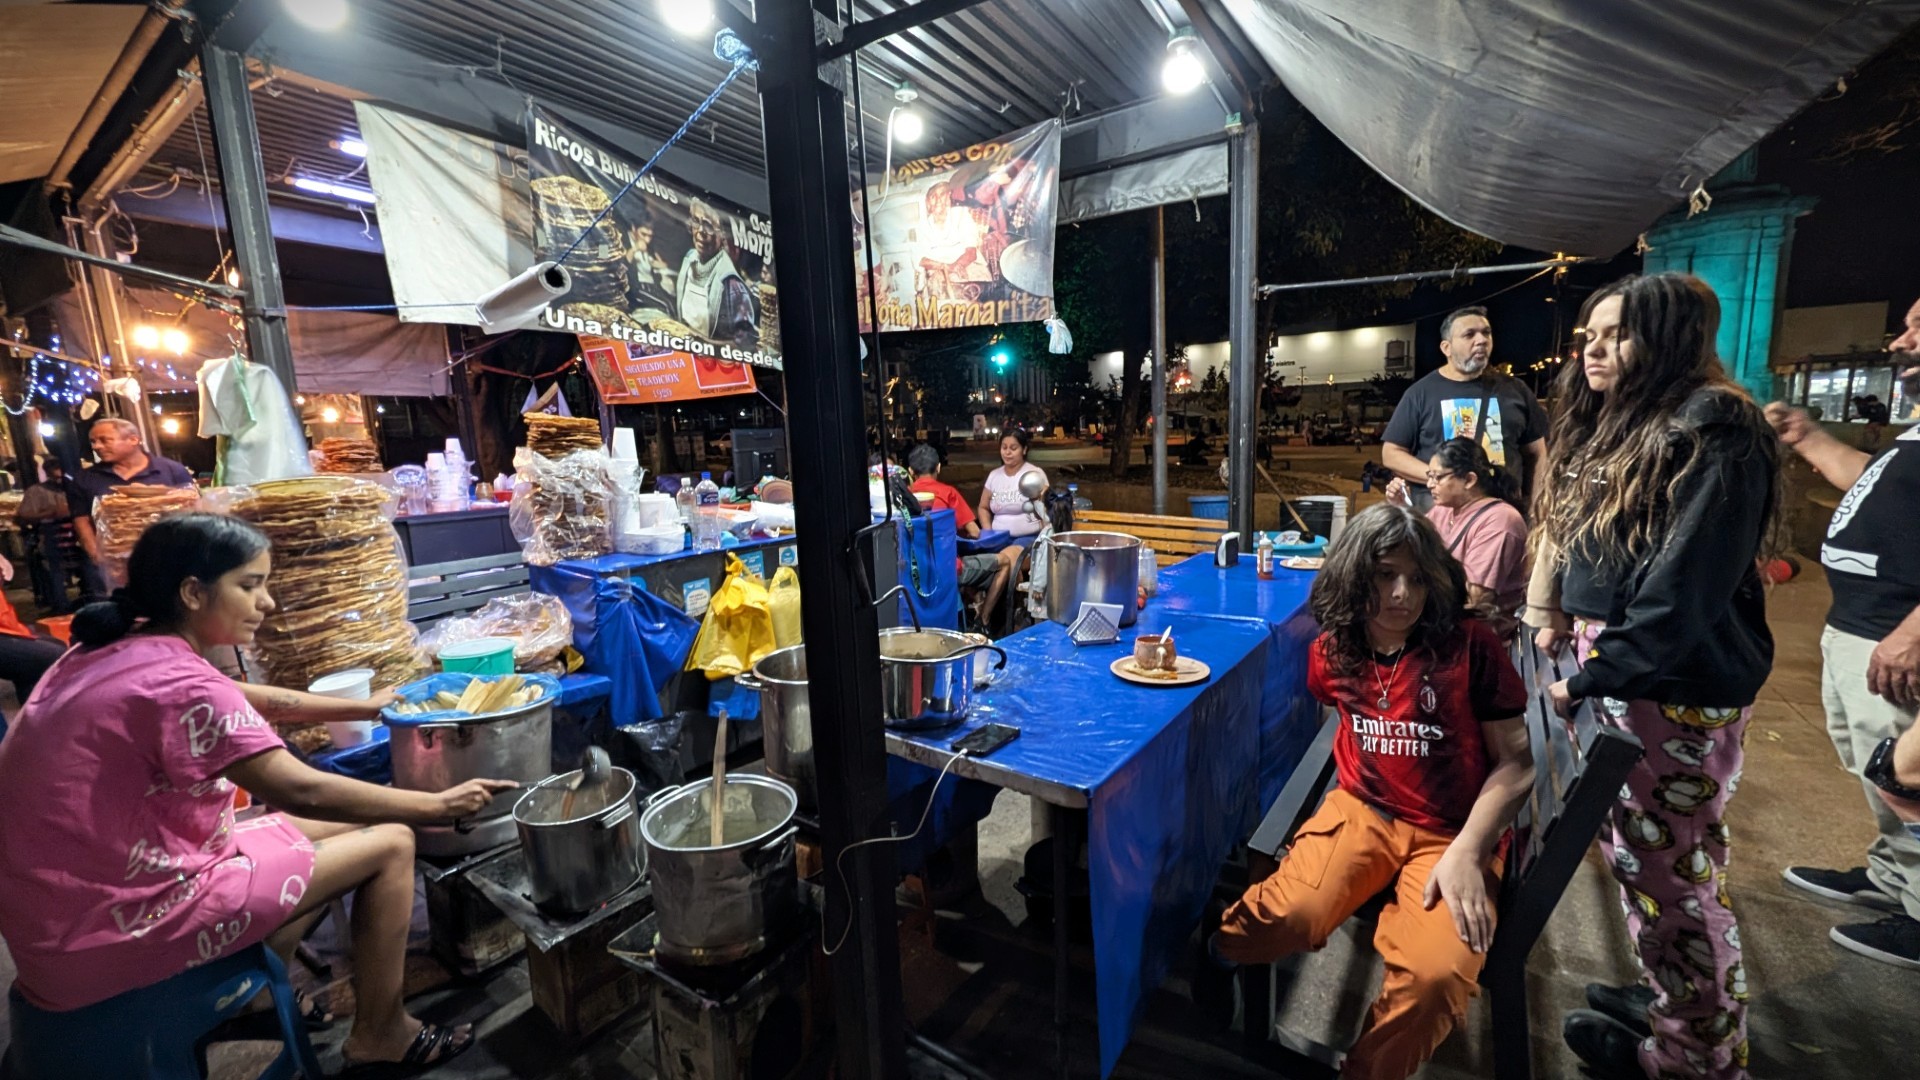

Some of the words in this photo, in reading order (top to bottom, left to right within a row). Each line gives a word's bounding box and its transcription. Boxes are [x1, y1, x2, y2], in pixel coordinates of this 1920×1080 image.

[535, 117, 595, 167] Ricos
[598, 150, 679, 204] Buñuelos
[728, 215, 774, 265] Marg
[916, 289, 1051, 328] Margarita
[545, 306, 603, 336] Una
[610, 321, 715, 356] tradicion
[720, 344, 774, 366] desde
[624, 362, 666, 374] SIGUIENDO
[667, 358, 686, 370] UNA
[637, 373, 680, 386] TRADICION
[179, 700, 266, 757] Barb
[1352, 714, 1444, 740] Emirates
[1380, 738, 1430, 757] BETTER
